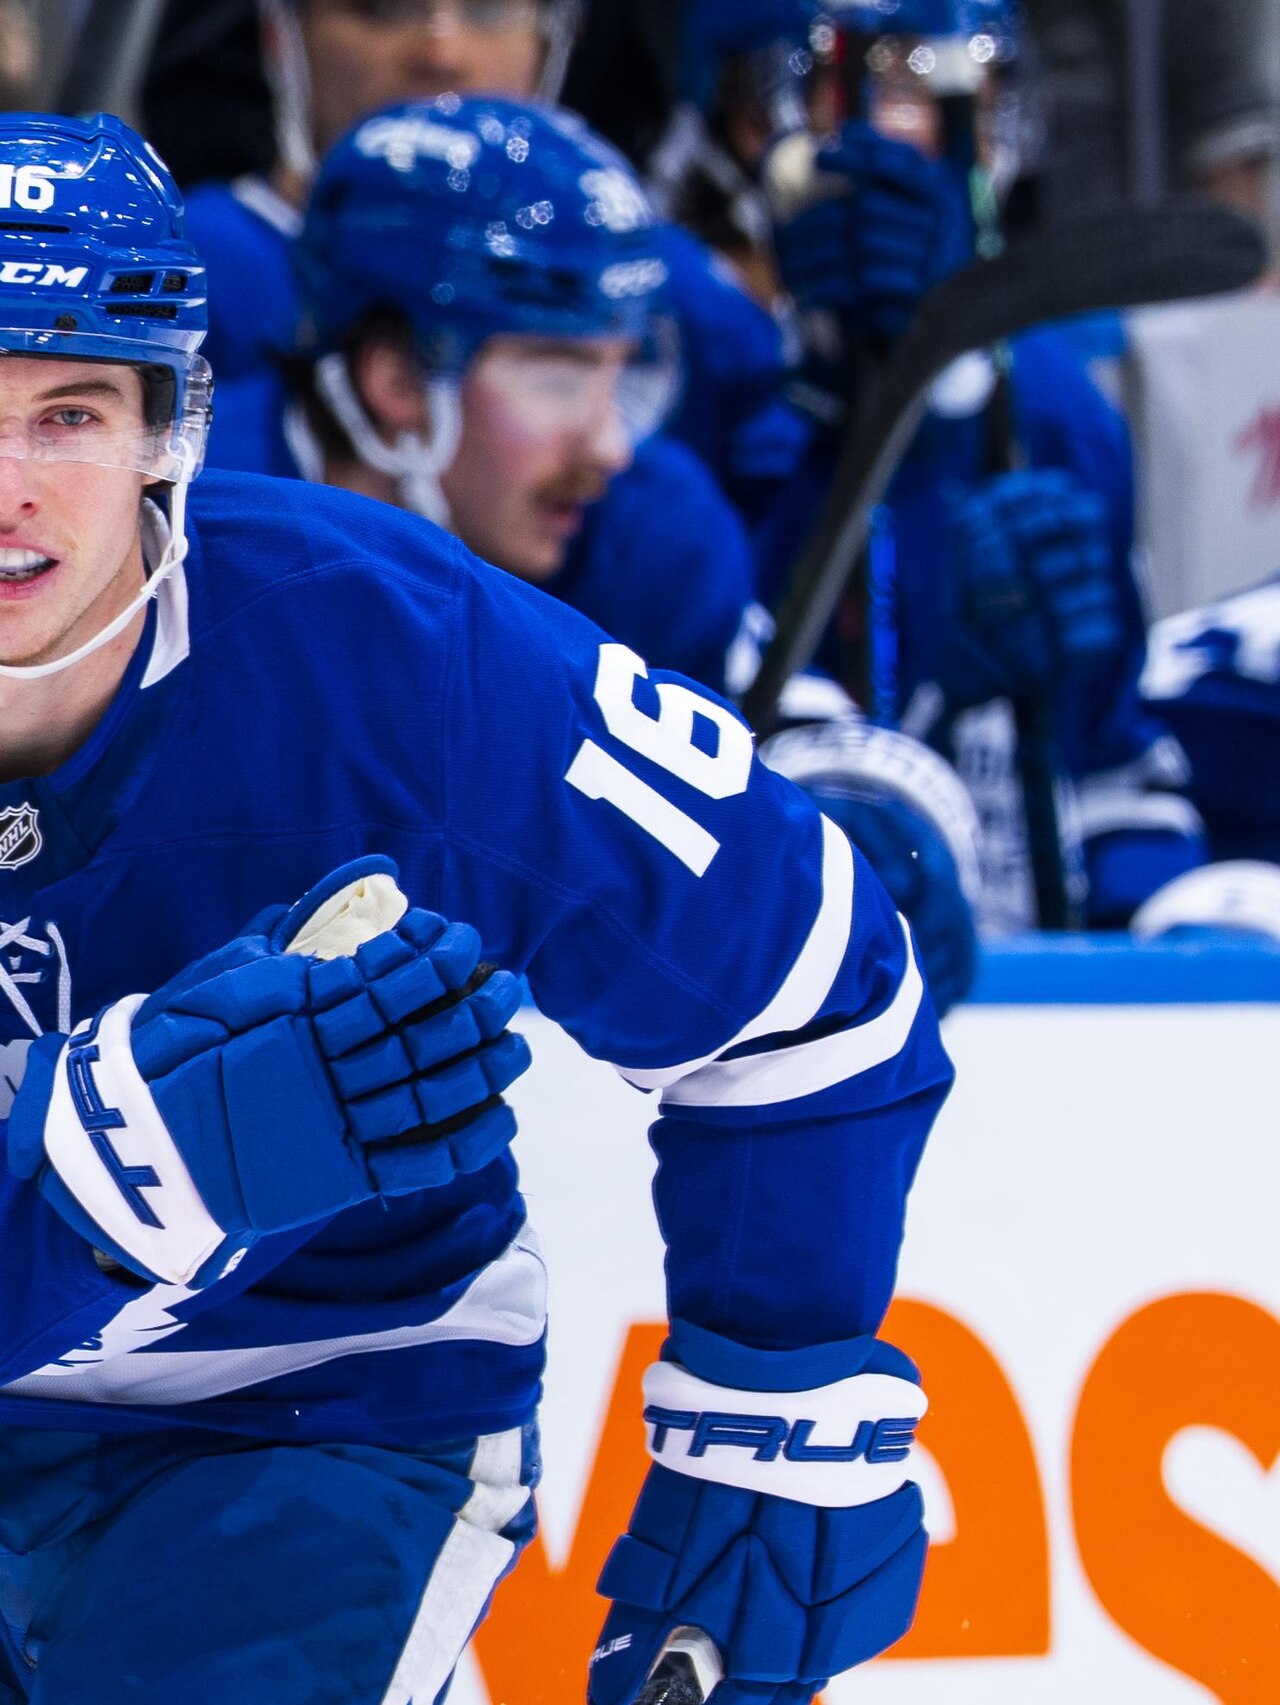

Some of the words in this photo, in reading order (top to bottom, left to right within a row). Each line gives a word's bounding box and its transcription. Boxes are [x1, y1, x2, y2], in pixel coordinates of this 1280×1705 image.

[564, 642, 755, 878] 16
[643, 1405, 920, 1464] TRUE
[589, 1632, 633, 1668] RUE
